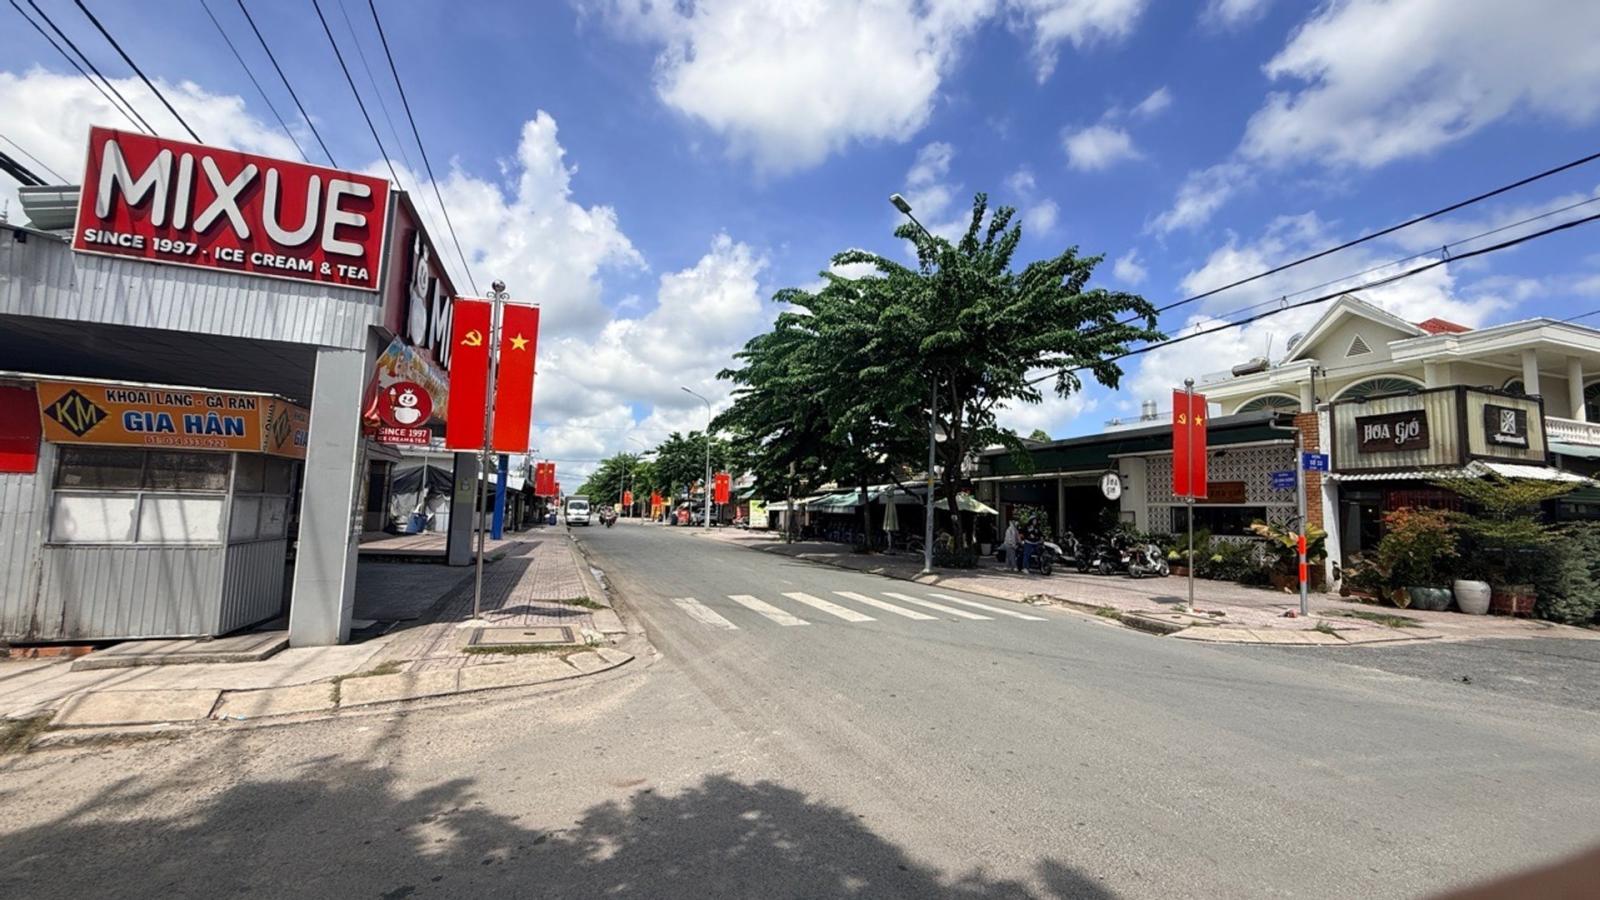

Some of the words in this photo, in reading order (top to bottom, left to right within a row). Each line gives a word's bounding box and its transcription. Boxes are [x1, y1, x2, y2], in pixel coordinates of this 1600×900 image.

[95, 139, 371, 257] MIXUE
[84, 228, 144, 249] SINCE
[153, 237, 198, 255] 1997
[215, 246, 244, 262] ICE
[250, 252, 313, 274] CREAM
[320, 262, 331, 276] &
[337, 264, 369, 280] TEA
[106, 390, 151, 404] KHOAI
[123, 410, 175, 433] GIA
[184, 412, 246, 437] HÂN
[379, 427, 406, 436] SINCE
[409, 428, 427, 437] 1997
[1363, 423, 1391, 444] HOA
